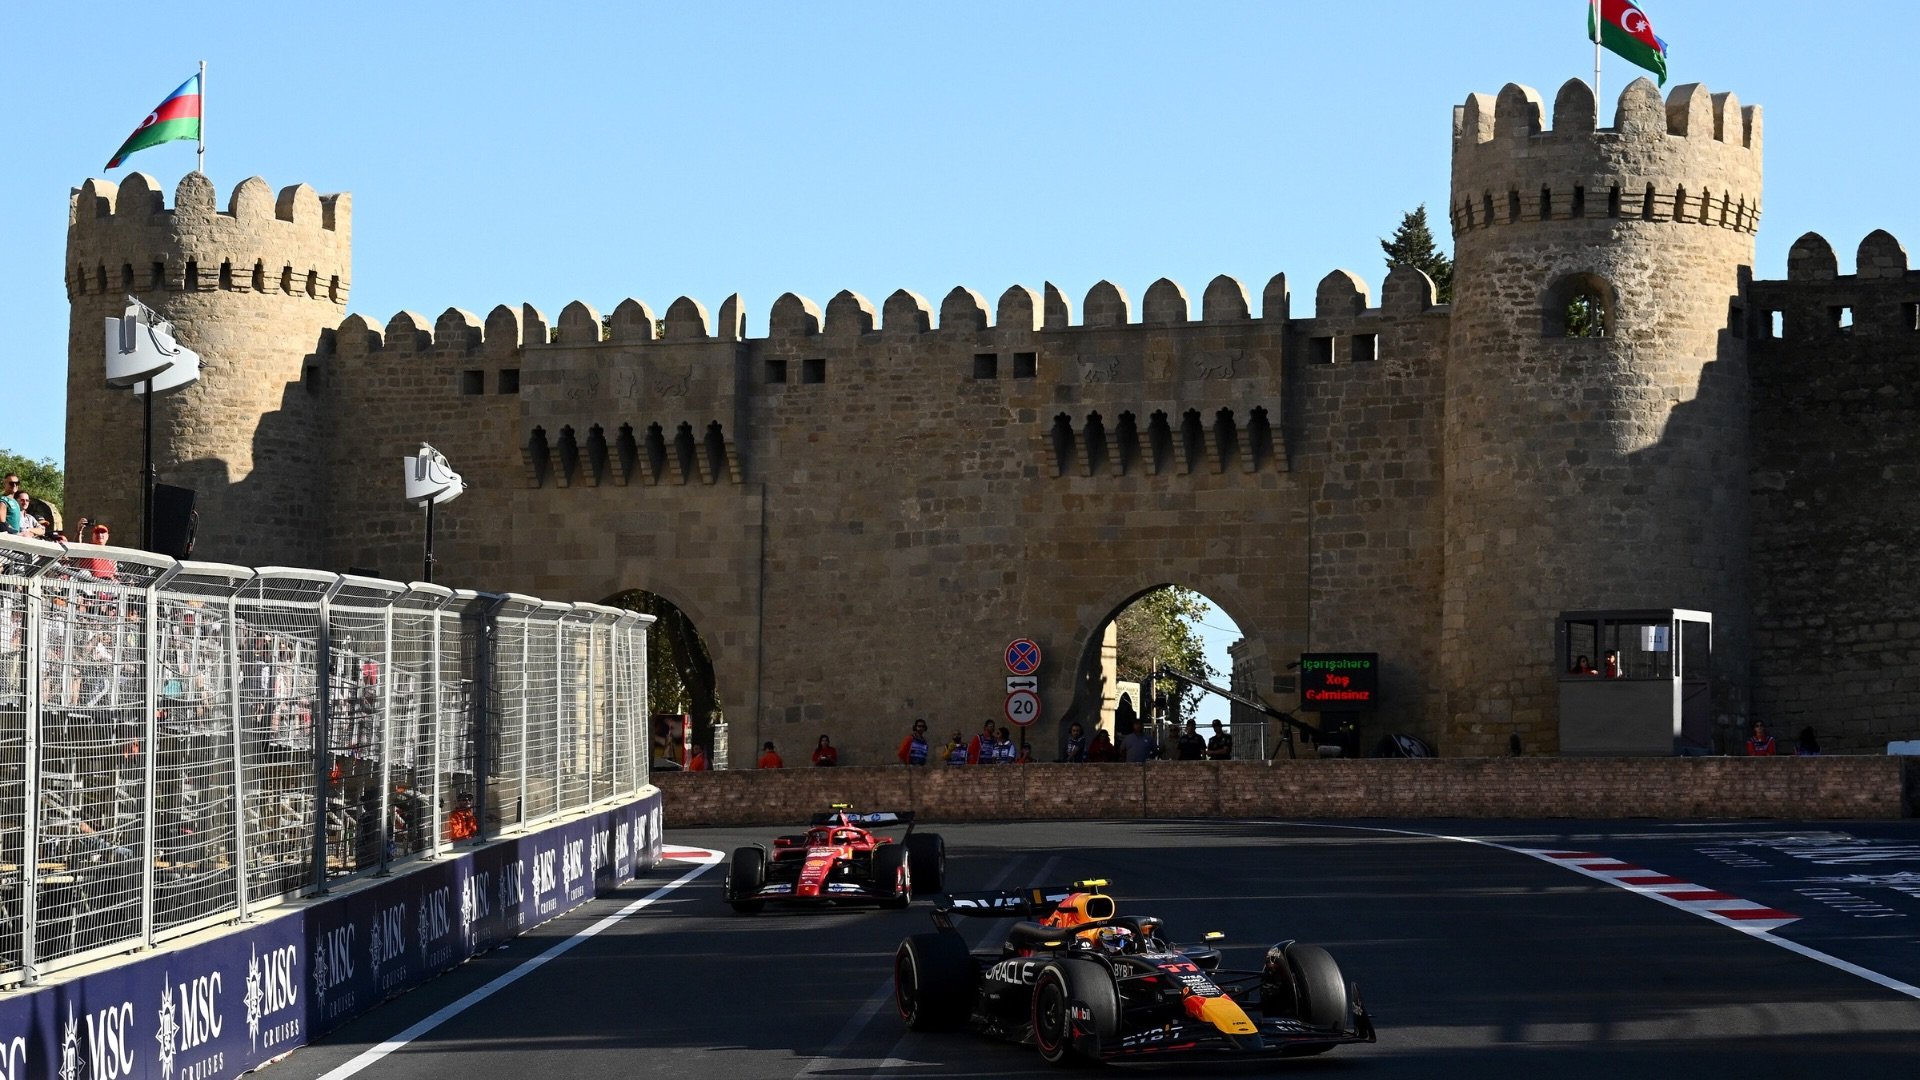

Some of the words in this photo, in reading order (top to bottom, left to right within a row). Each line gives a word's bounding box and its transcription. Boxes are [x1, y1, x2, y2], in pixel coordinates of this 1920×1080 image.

[1013, 700, 1033, 714] 20
[540, 849, 556, 893] MSC
[569, 839, 583, 880] MSC
[471, 871, 490, 921] MSC
[507, 860, 524, 906] MSC
[383, 903, 406, 962] MSC
[429, 886, 450, 940] MSC
[328, 923, 354, 987] MSC
[985, 961, 1036, 985] ORACLE
[1114, 962, 1133, 977] BYBIT
[264, 945, 297, 1015] MSC
[180, 971, 222, 1051] MSC
[264, 1019, 299, 1048] CRUISES
[1071, 1006, 1090, 1020] Mobil
[86, 1002, 134, 1080] MSC
[181, 1052, 224, 1080] CRUISES
